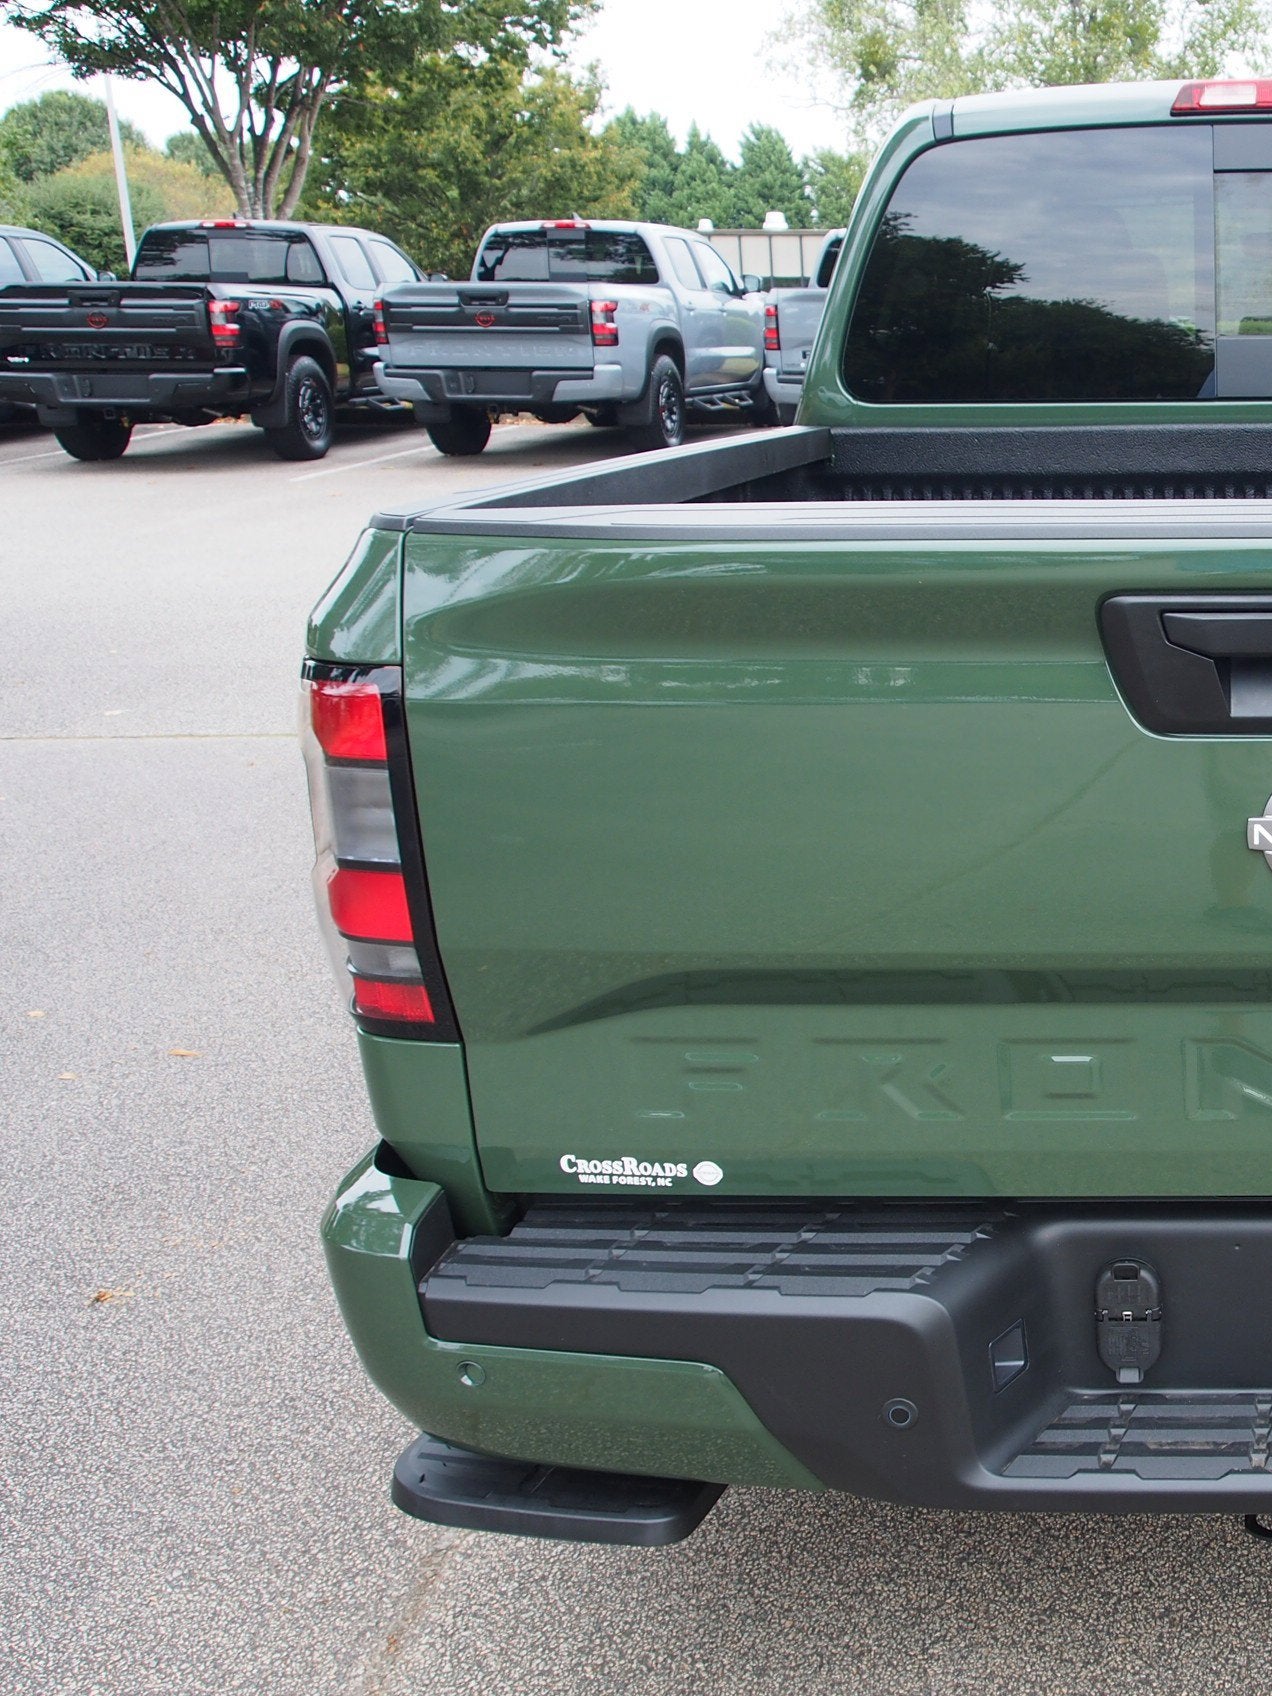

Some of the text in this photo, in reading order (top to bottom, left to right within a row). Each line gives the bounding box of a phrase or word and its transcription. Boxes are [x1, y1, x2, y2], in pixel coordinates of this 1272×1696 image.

[559, 1154, 688, 1177] CROSSROADS
[578, 1174, 673, 1187] WAKE FOREST, NC
